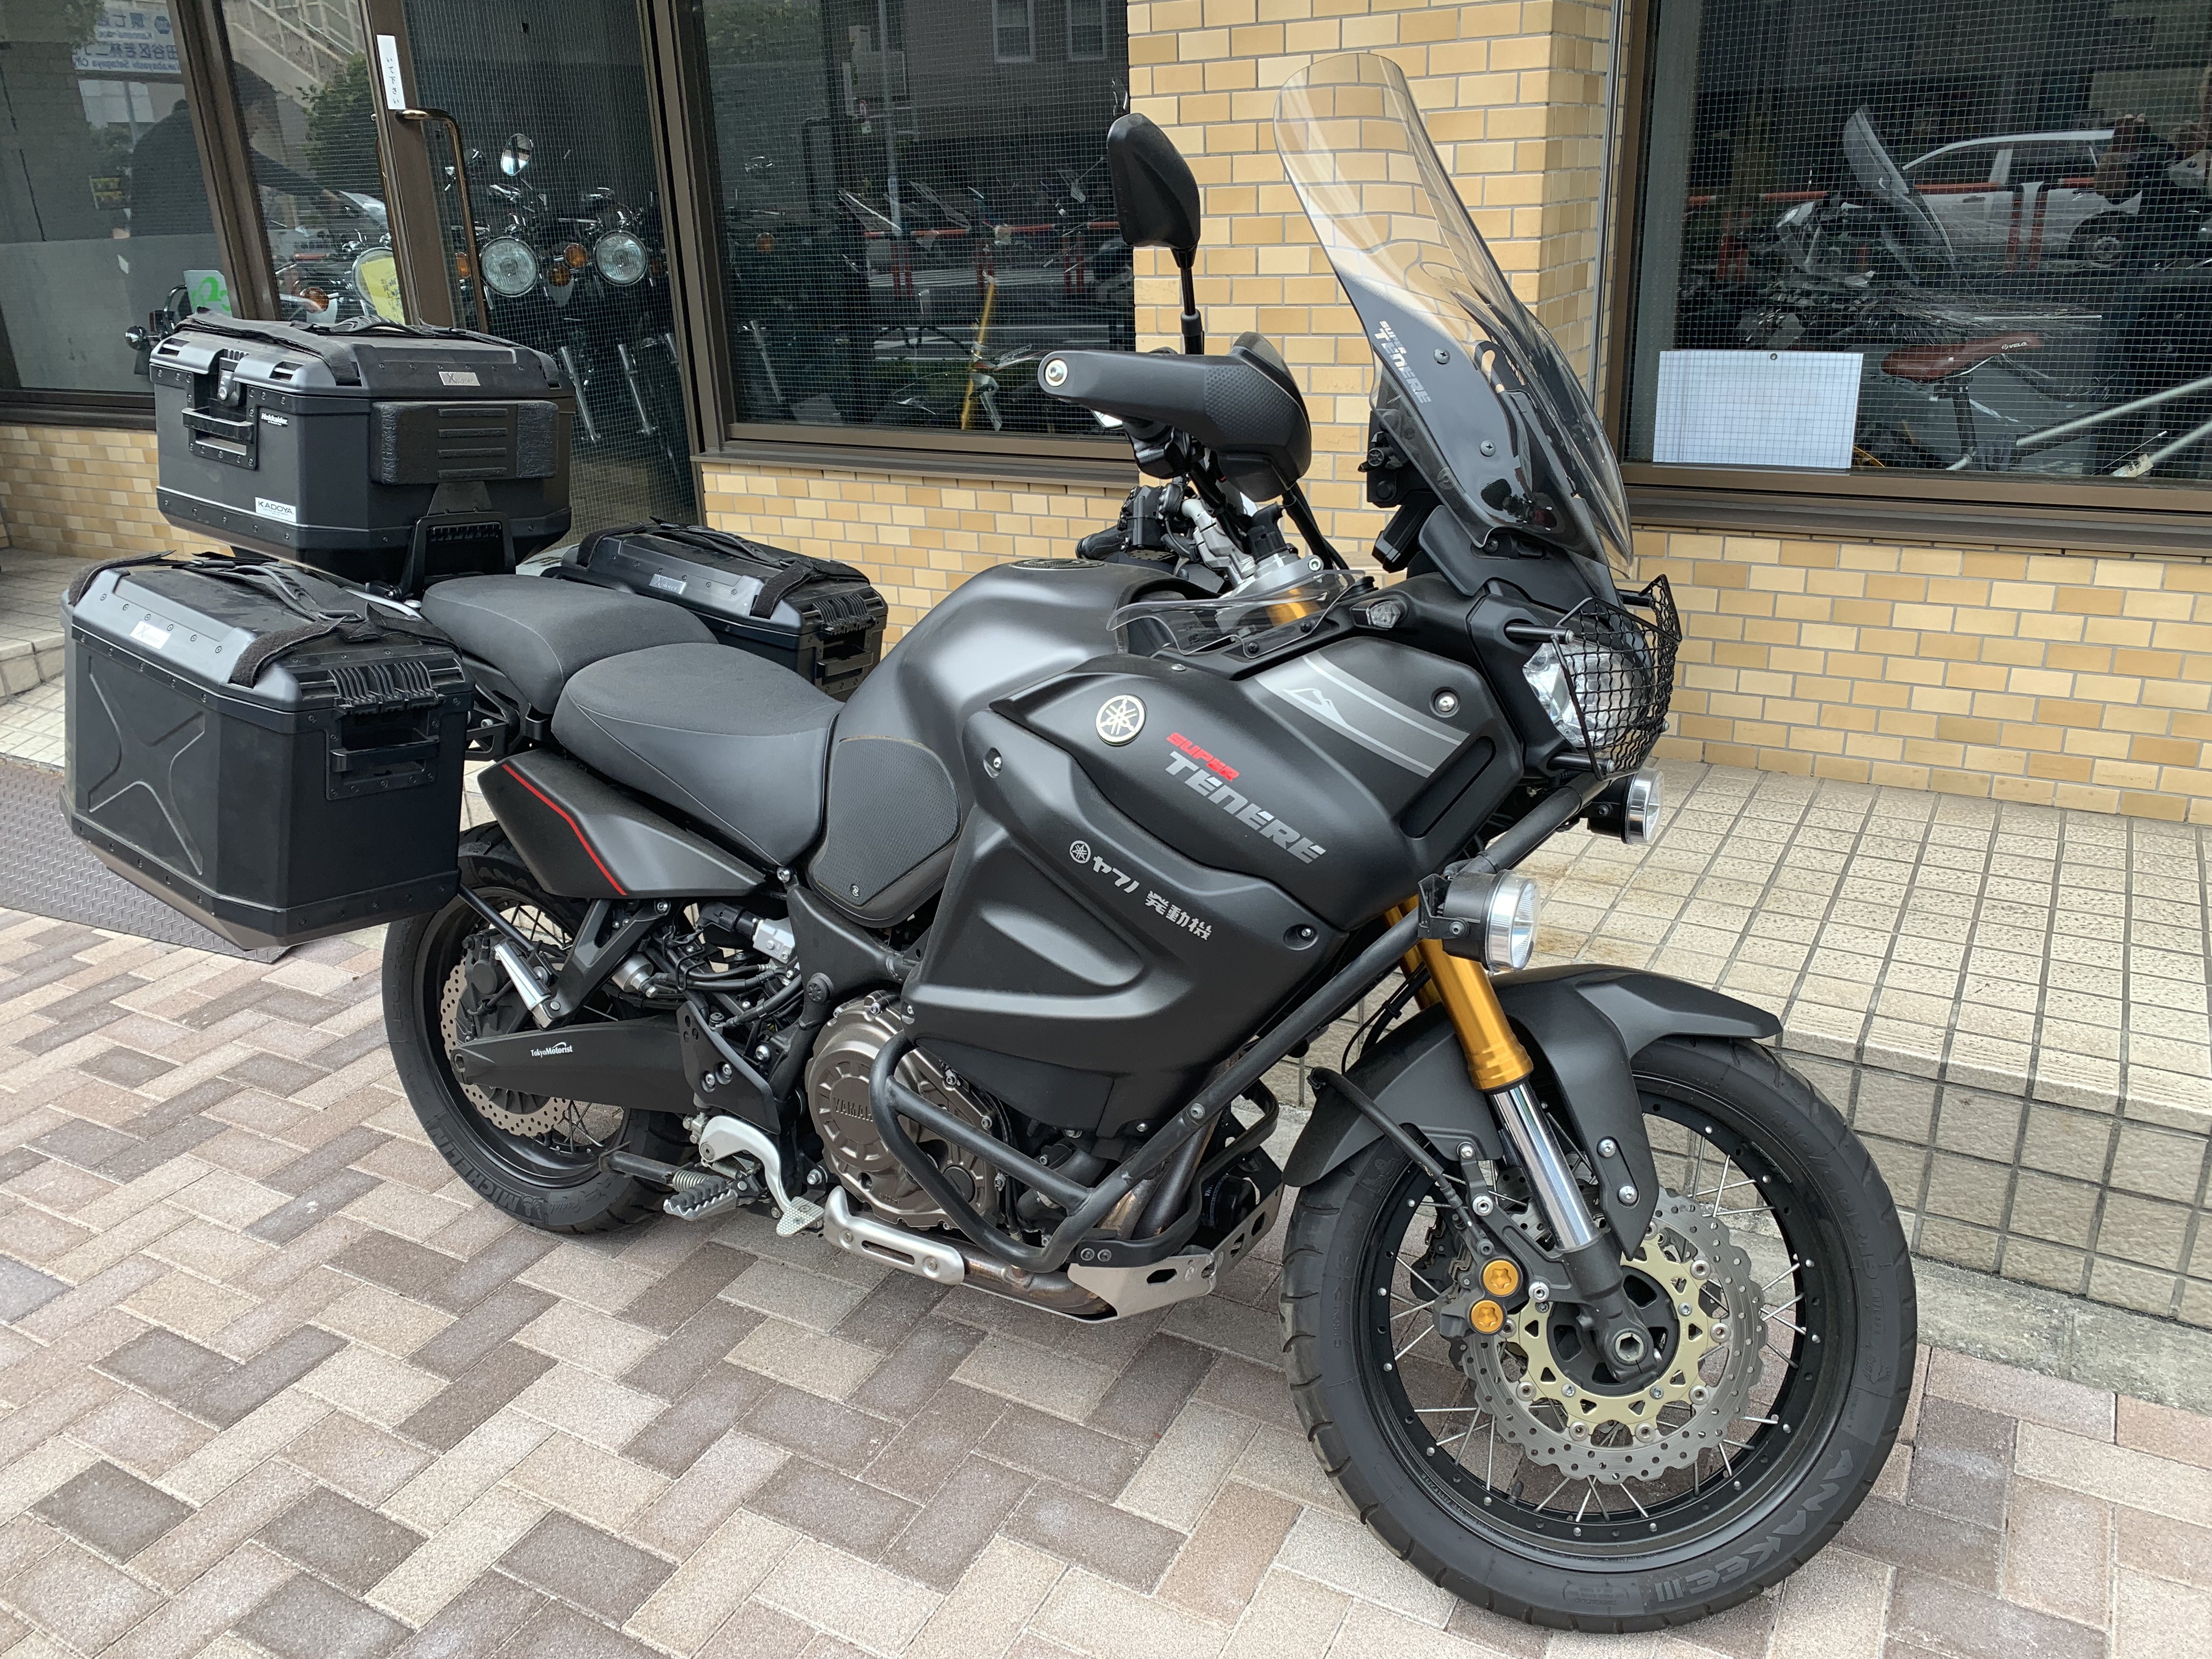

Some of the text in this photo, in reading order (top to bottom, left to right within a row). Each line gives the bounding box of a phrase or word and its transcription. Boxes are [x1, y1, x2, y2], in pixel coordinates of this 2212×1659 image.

[1379, 320, 1408, 355] SUPER
[447, 373, 474, 384] Xplorer
[258, 500, 294, 515] KADOYA
[1166, 732, 1240, 782] SUPER
[1145, 890, 1212, 941] 発動機
[833, 1097, 874, 1122] YAMAH
[430, 1127, 520, 1212] MICHELIN
[1685, 1449, 1854, 1594] ANAKEE
